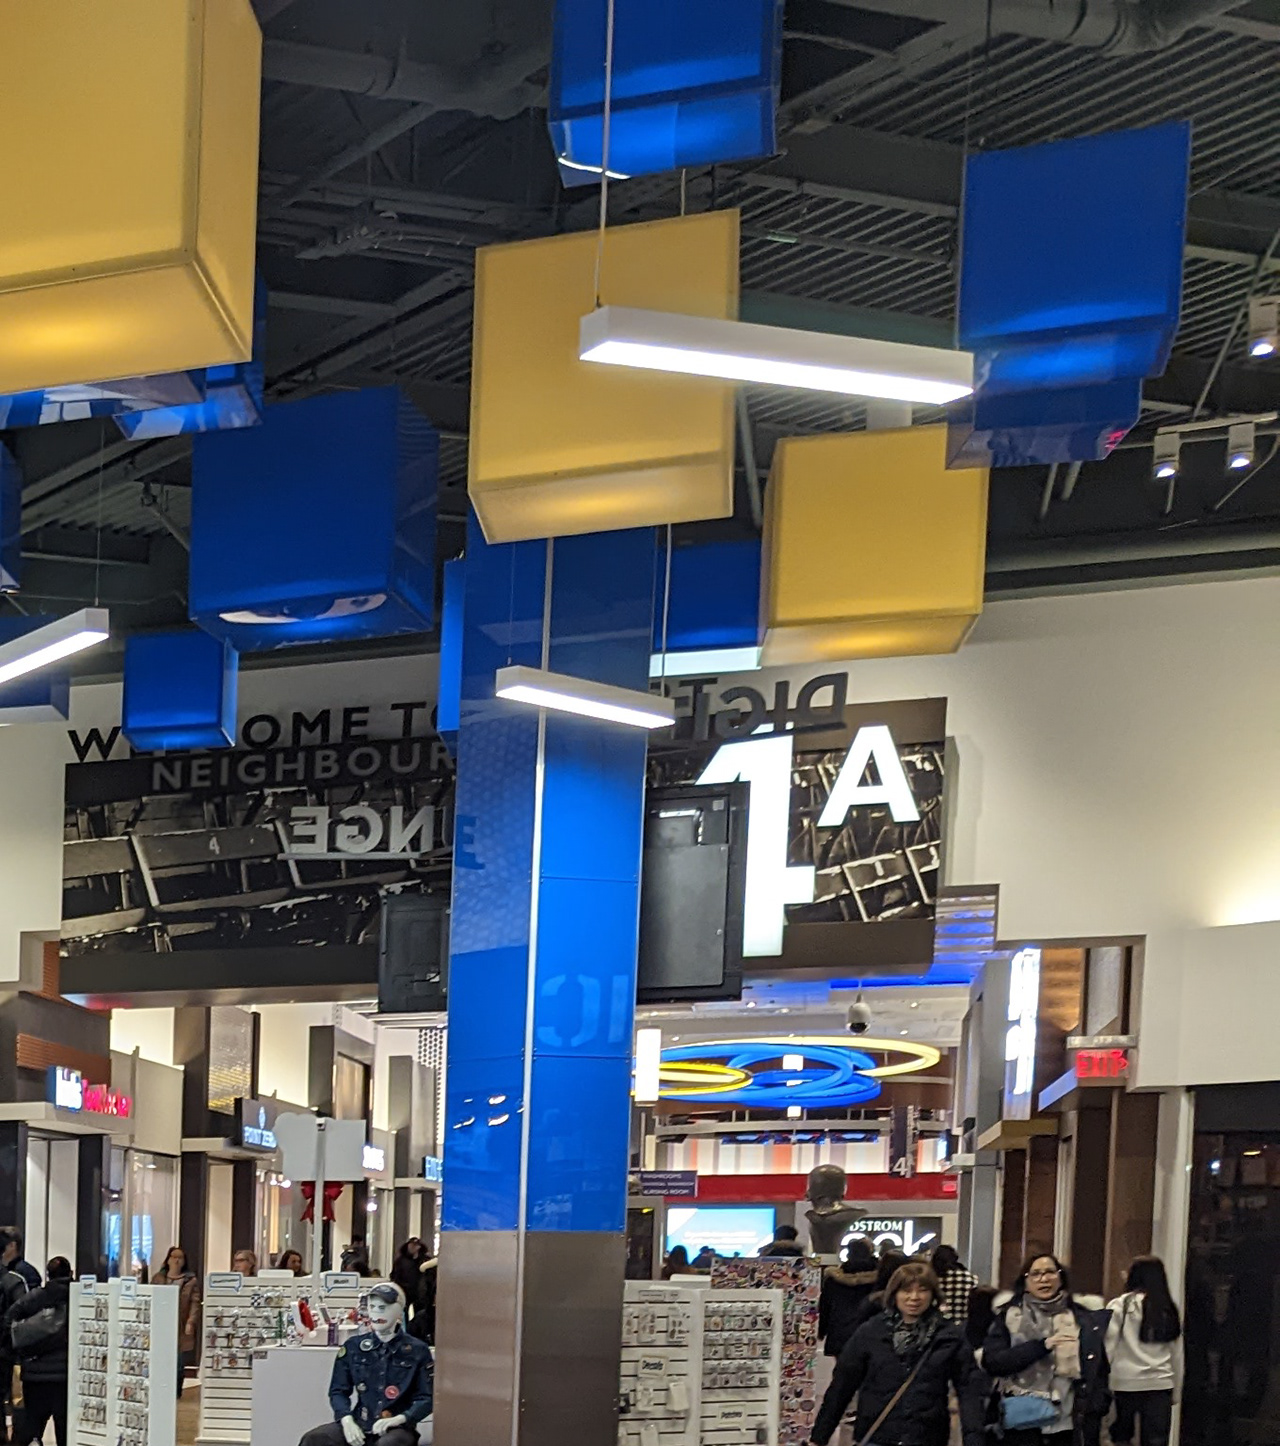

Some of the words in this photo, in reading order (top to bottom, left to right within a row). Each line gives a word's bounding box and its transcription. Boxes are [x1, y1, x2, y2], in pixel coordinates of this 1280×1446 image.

[67, 706, 368, 763] WOME
[389, 701, 438, 740] T
[1076, 1050, 1124, 1079] EXIT
